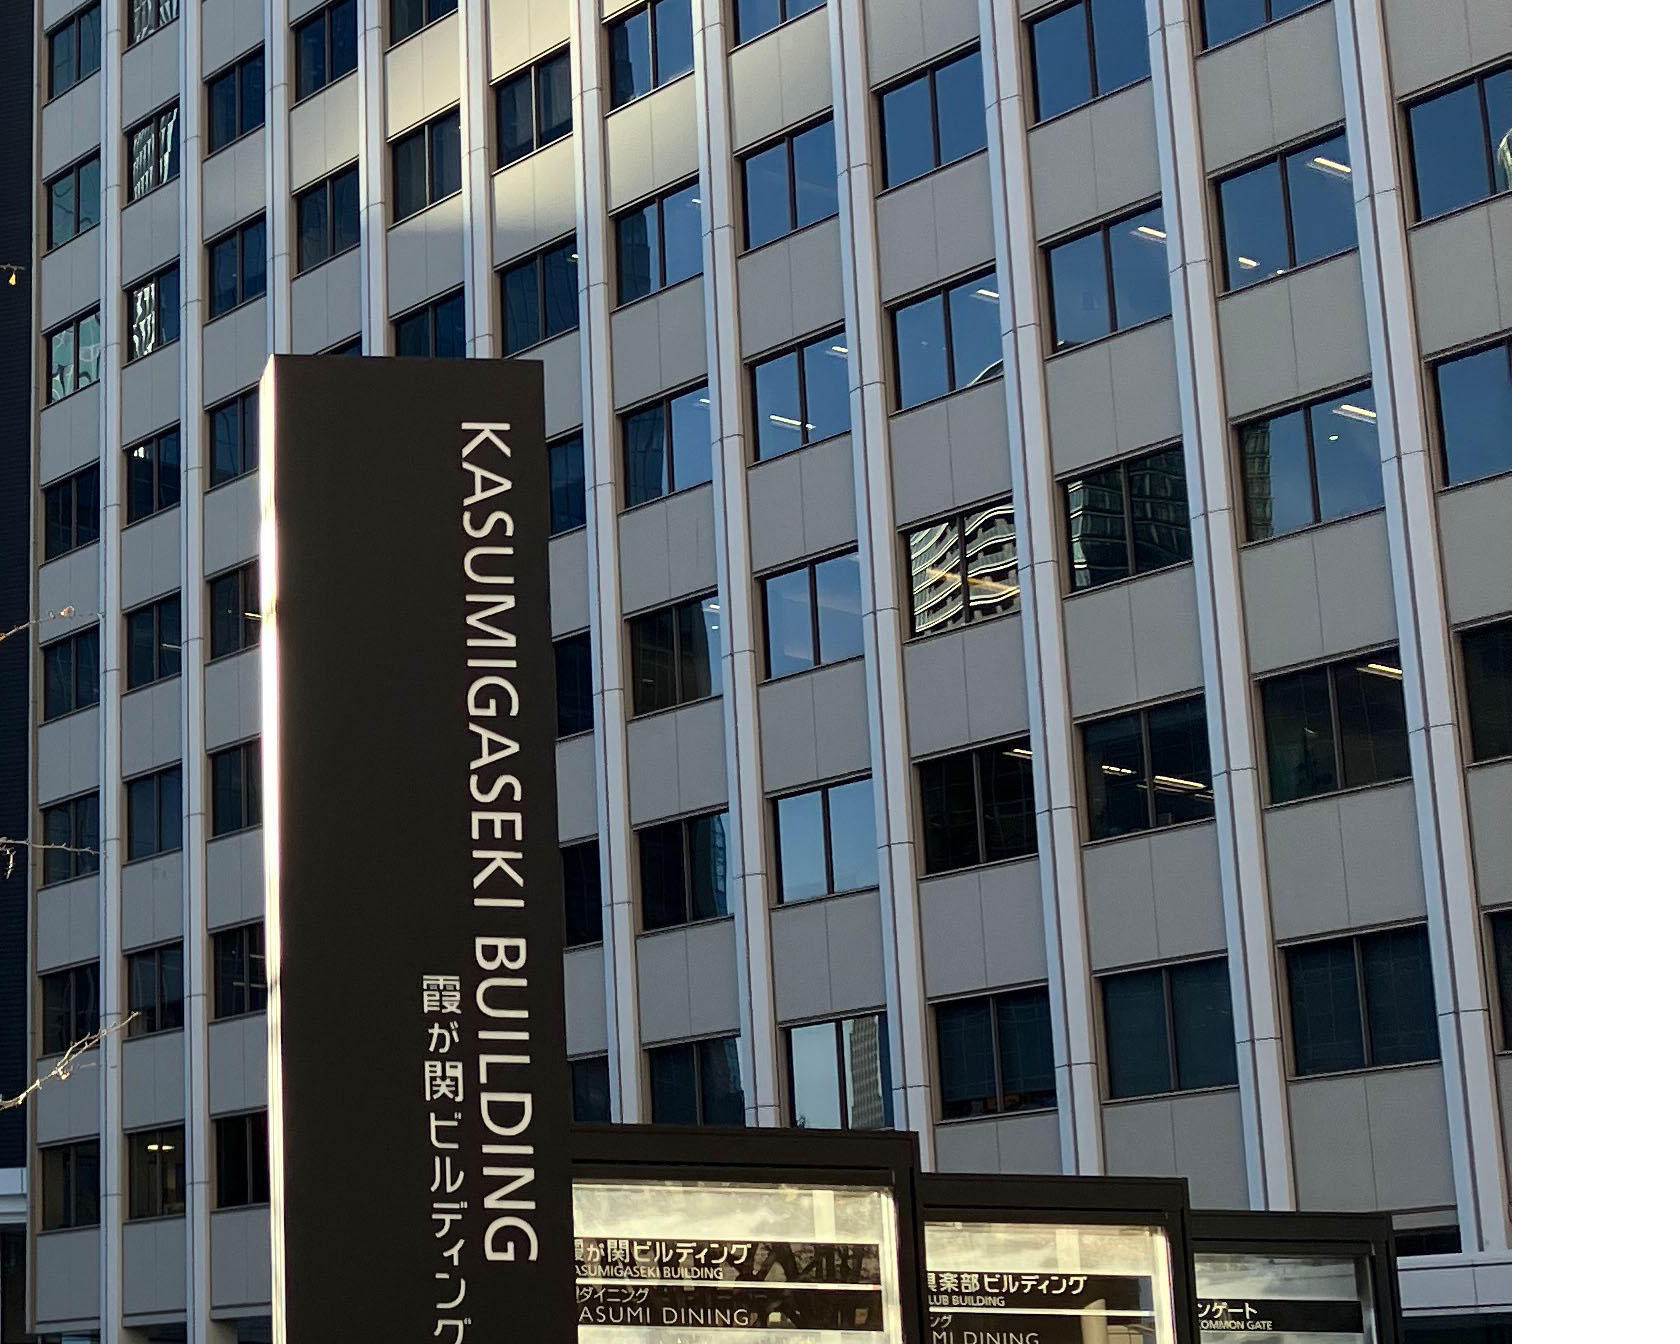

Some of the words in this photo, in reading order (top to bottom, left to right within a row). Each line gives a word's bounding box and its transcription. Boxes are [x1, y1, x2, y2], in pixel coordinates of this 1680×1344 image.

[461, 422, 525, 908] KASUMIGASEKI
[474, 935, 539, 1262] BUILDING
[663, 1265, 723, 1280] BUILDING
[952, 1295, 1006, 1307] BUILDING
[578, 1305, 651, 1324] ASUMI
[662, 1308, 749, 1326] DINING
[1199, 1319, 1245, 1331] OMMON
[1247, 1320, 1273, 1331] GATE
